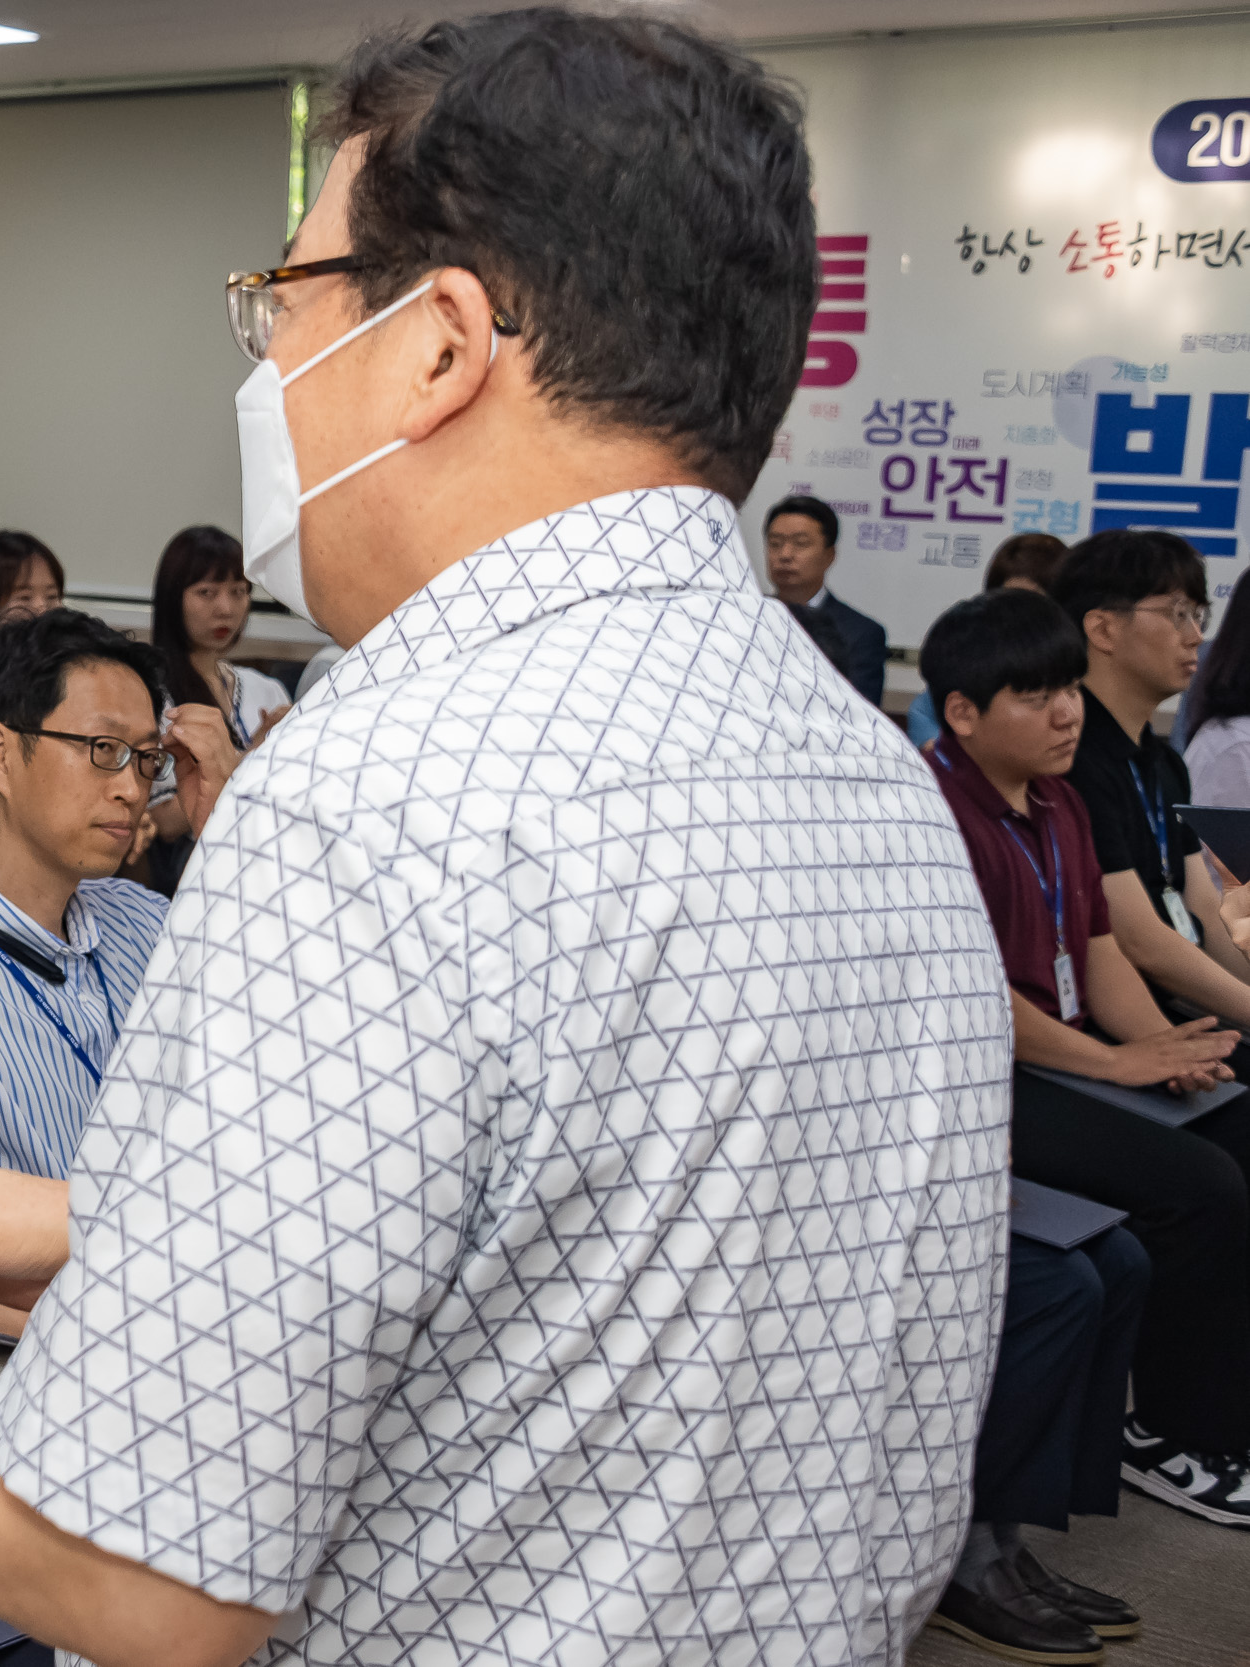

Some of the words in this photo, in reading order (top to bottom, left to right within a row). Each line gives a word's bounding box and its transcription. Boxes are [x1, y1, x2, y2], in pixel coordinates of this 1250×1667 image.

[955, 223, 1044, 275] 항상
[980, 368, 1091, 399] 도시계획
[862, 399, 956, 446] 성장
[881, 455, 1009, 523] 안전
[1012, 499, 1081, 535] 균형
[857, 522, 908, 551] 환경
[918, 532, 982, 569] 교통
